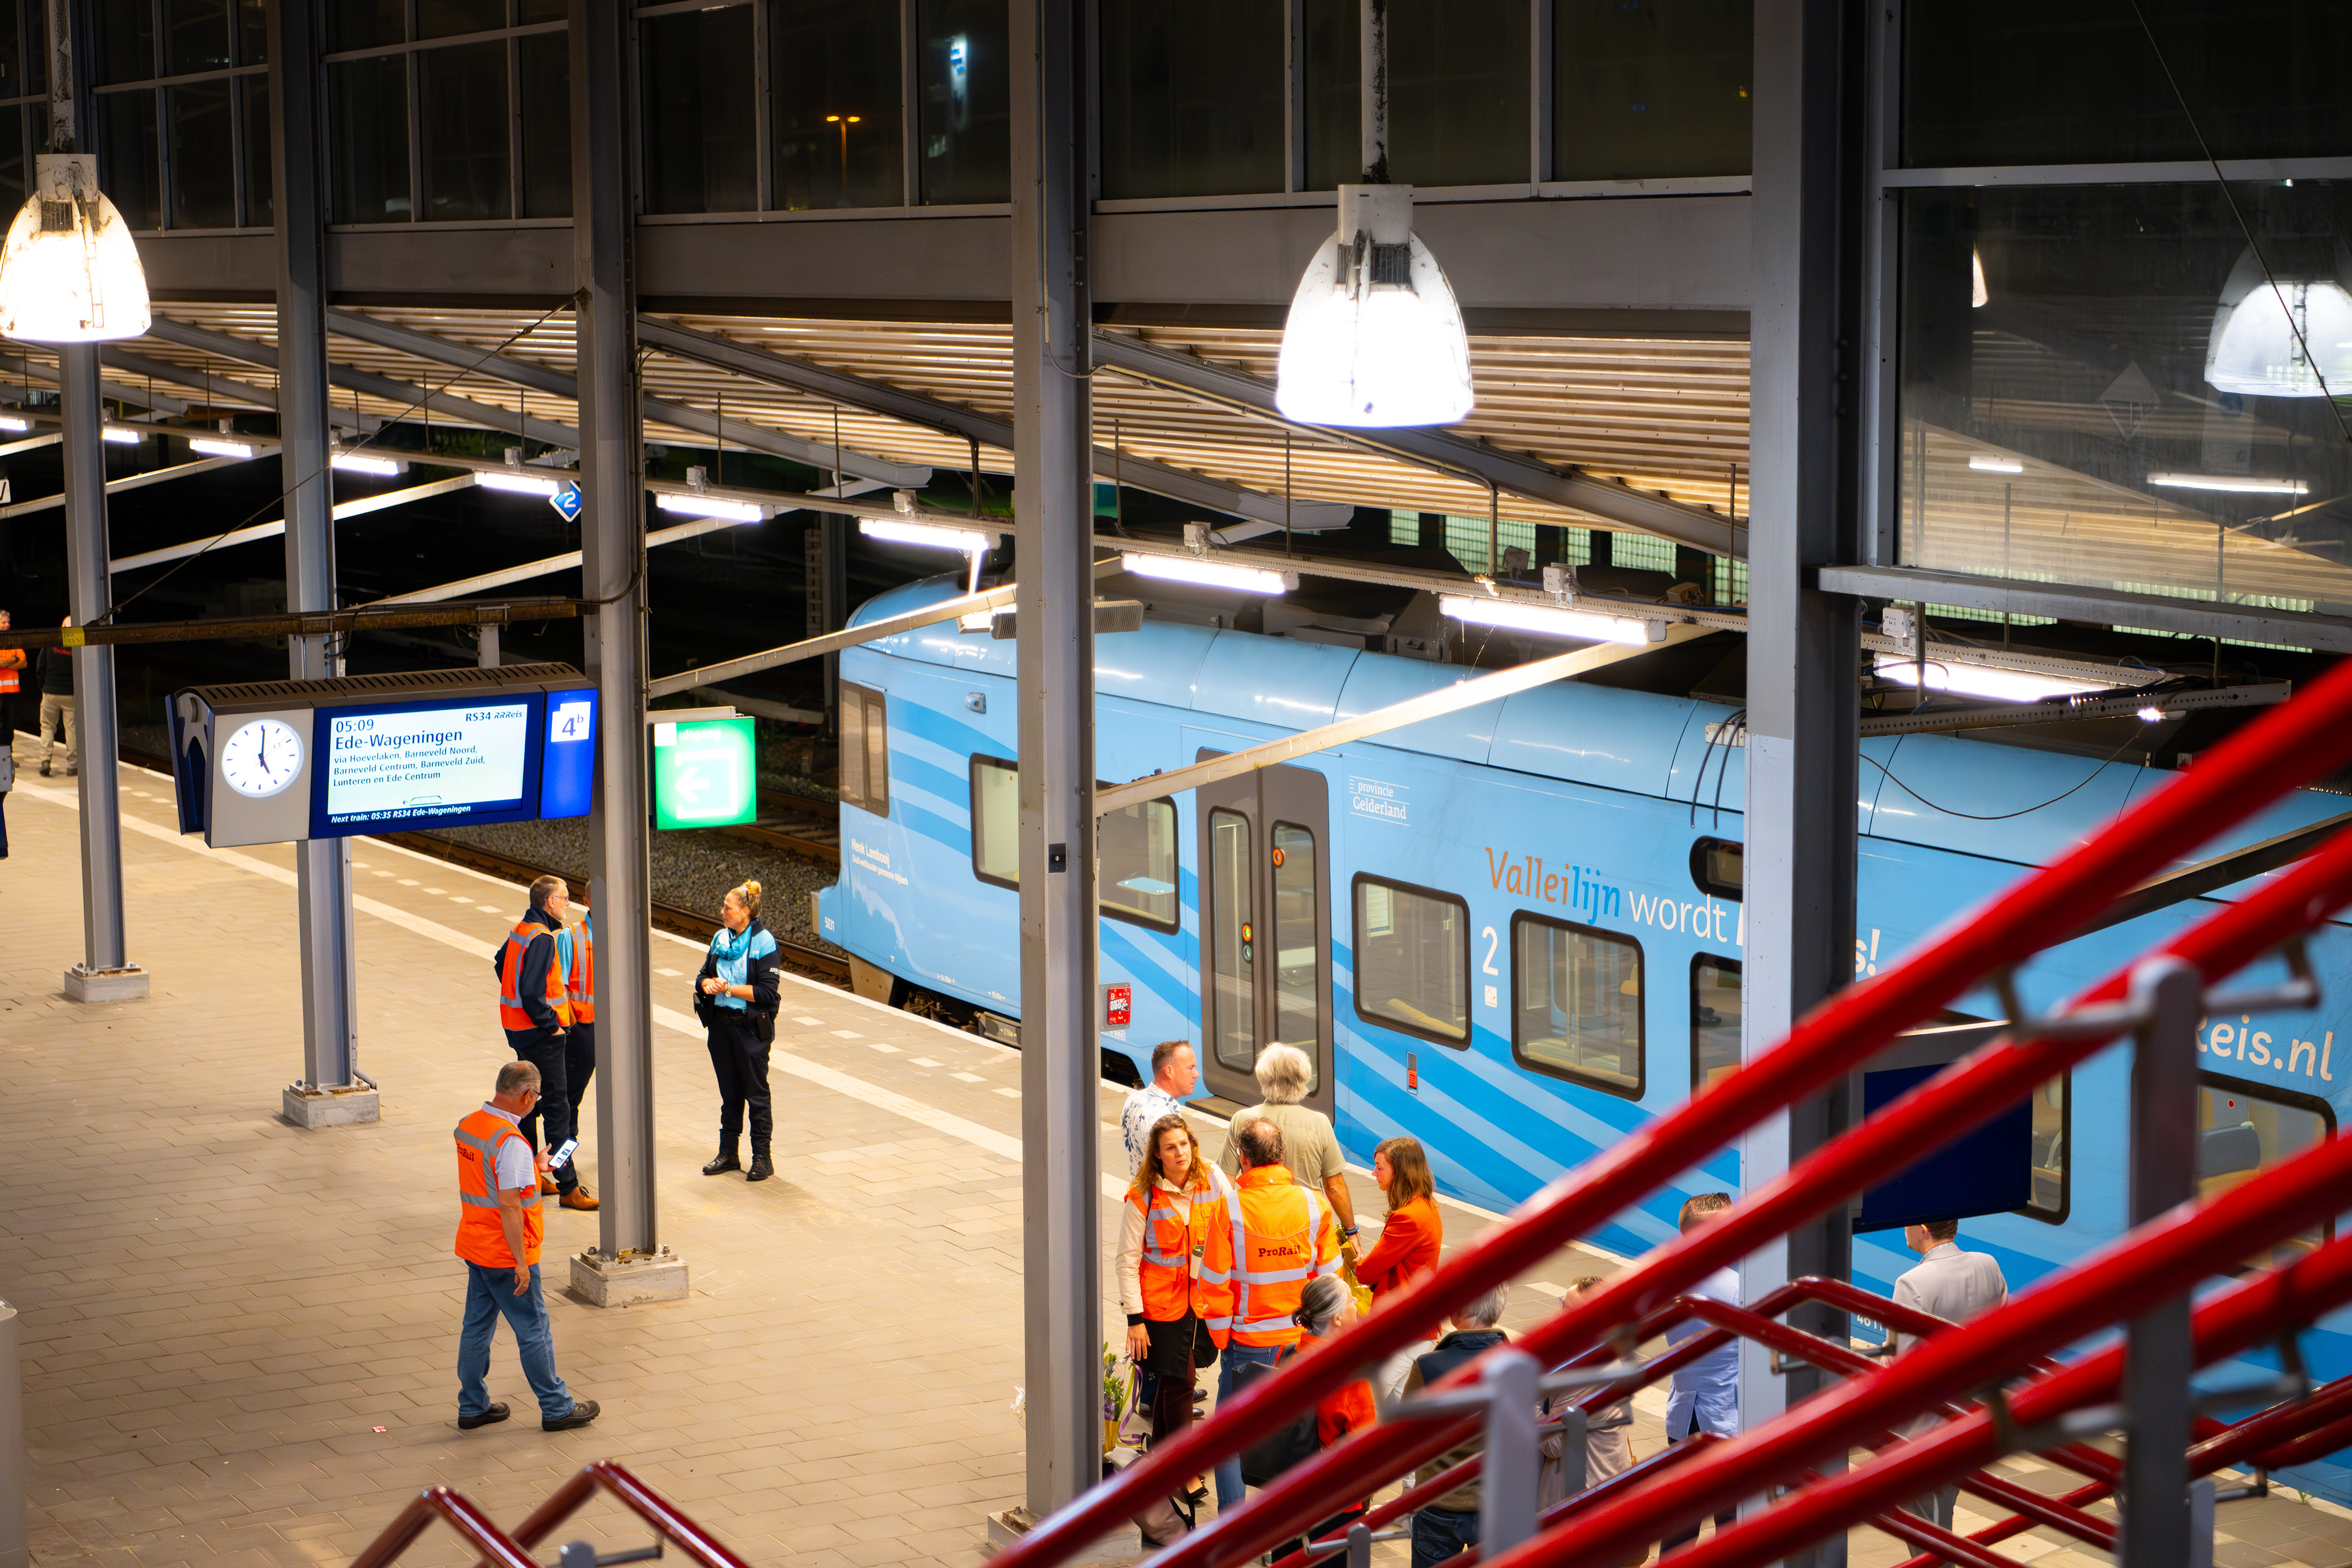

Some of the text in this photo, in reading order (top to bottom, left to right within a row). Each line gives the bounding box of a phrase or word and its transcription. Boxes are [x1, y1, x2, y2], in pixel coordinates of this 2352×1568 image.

[564, 491, 577, 508] 2
[466, 712, 491, 722] RS34
[336, 719, 374, 733] 05:09
[336, 730, 462, 750] Ede-Wageningen
[679, 729, 721, 742] uitgang
[350, 752, 402, 762] Hoevelaken,
[405, 747, 447, 758] Barneveld
[450, 745, 477, 755] Noord,
[334, 756, 485, 775] Barneveld Centrum, Barneveld Zuid,
[333, 777, 371, 787] Lunteren
[387, 774, 402, 782] Ede
[405, 772, 440, 781] Centrum
[1358, 782, 1394, 798] provincie
[331, 805, 471, 823] Next train: 05:35 RS34 Ede-Wageningen
[1353, 796, 1407, 819] Gelderland
[851, 838, 890, 869] Henk Lambooij
[1485, 847, 1620, 925] Valleilijn
[1628, 891, 1728, 943] wordt
[824, 916, 835, 932] 5031
[1482, 926, 1498, 976] 2
[1258, 1245, 1301, 1257] ProRail
